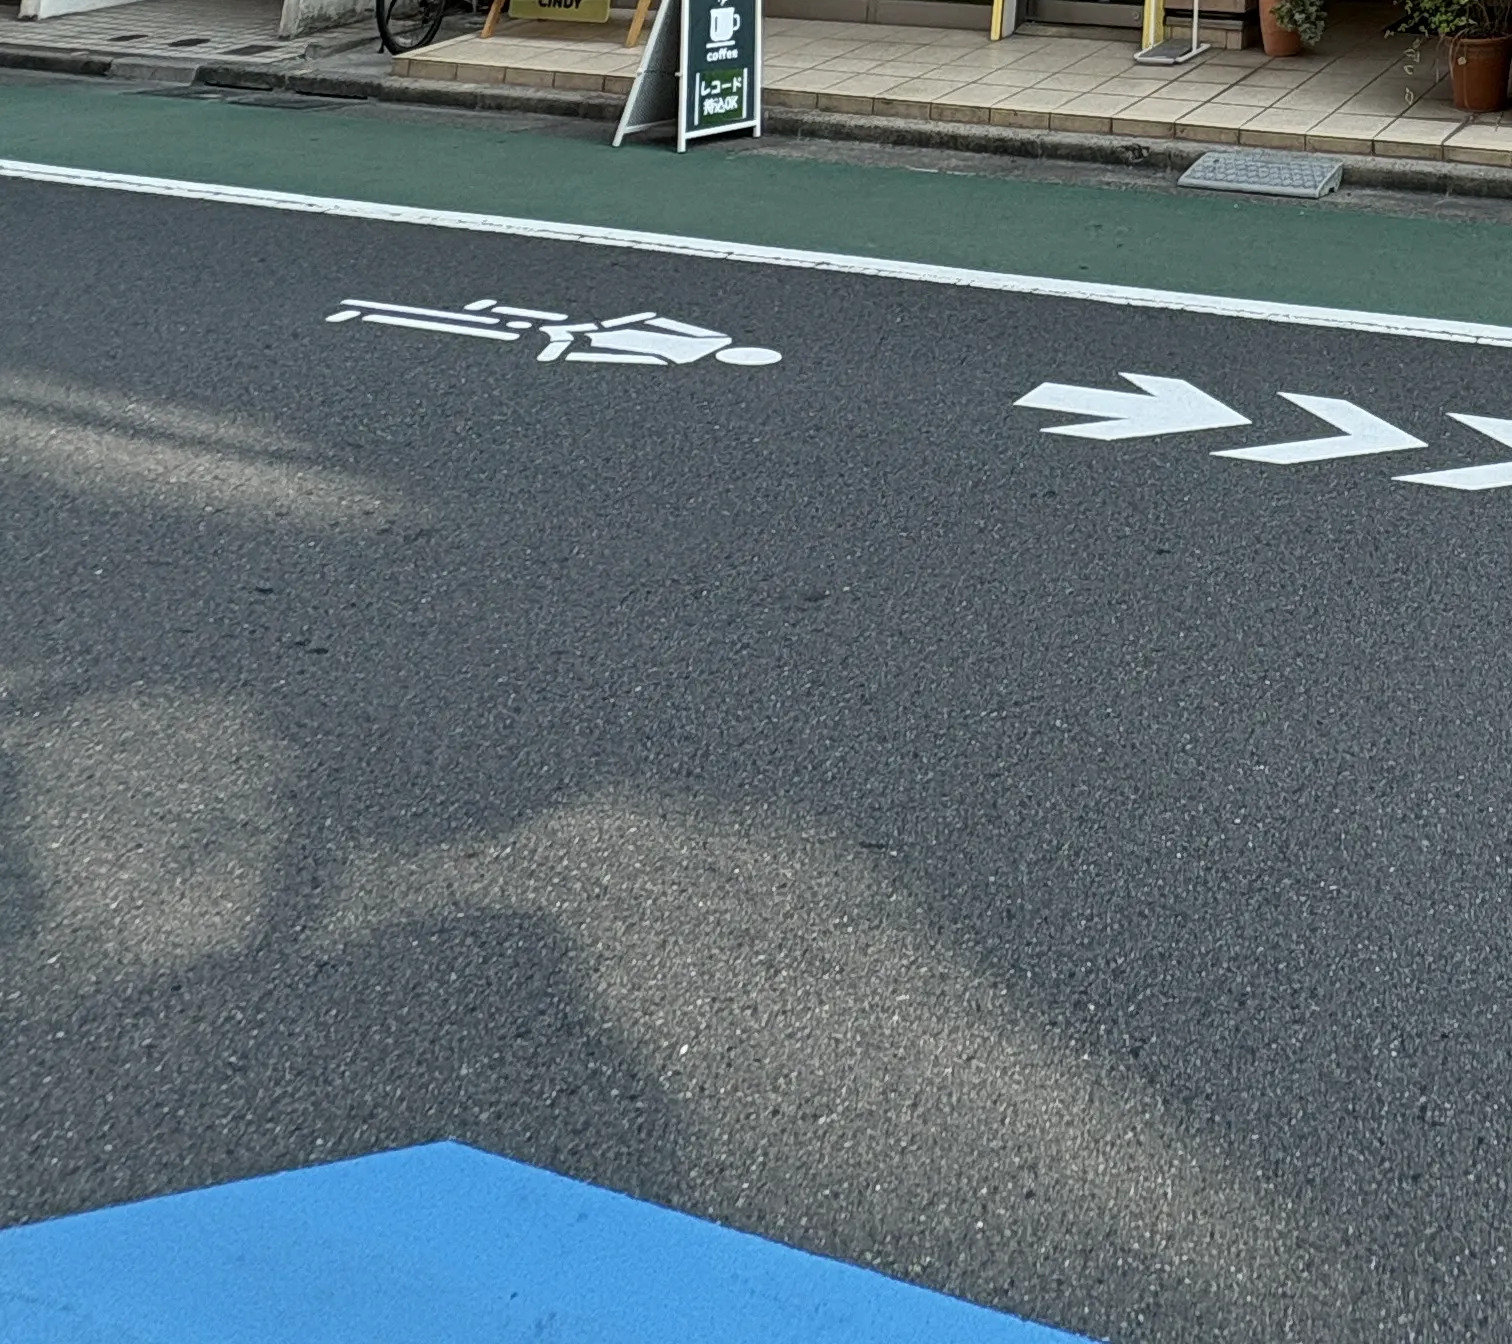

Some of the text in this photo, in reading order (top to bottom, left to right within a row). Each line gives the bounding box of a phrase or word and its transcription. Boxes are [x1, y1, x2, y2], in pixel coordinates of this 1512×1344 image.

[706, 47, 739, 62] coffee
[700, 76, 743, 96] レコード
[702, 95, 739, 116] 持込OK
